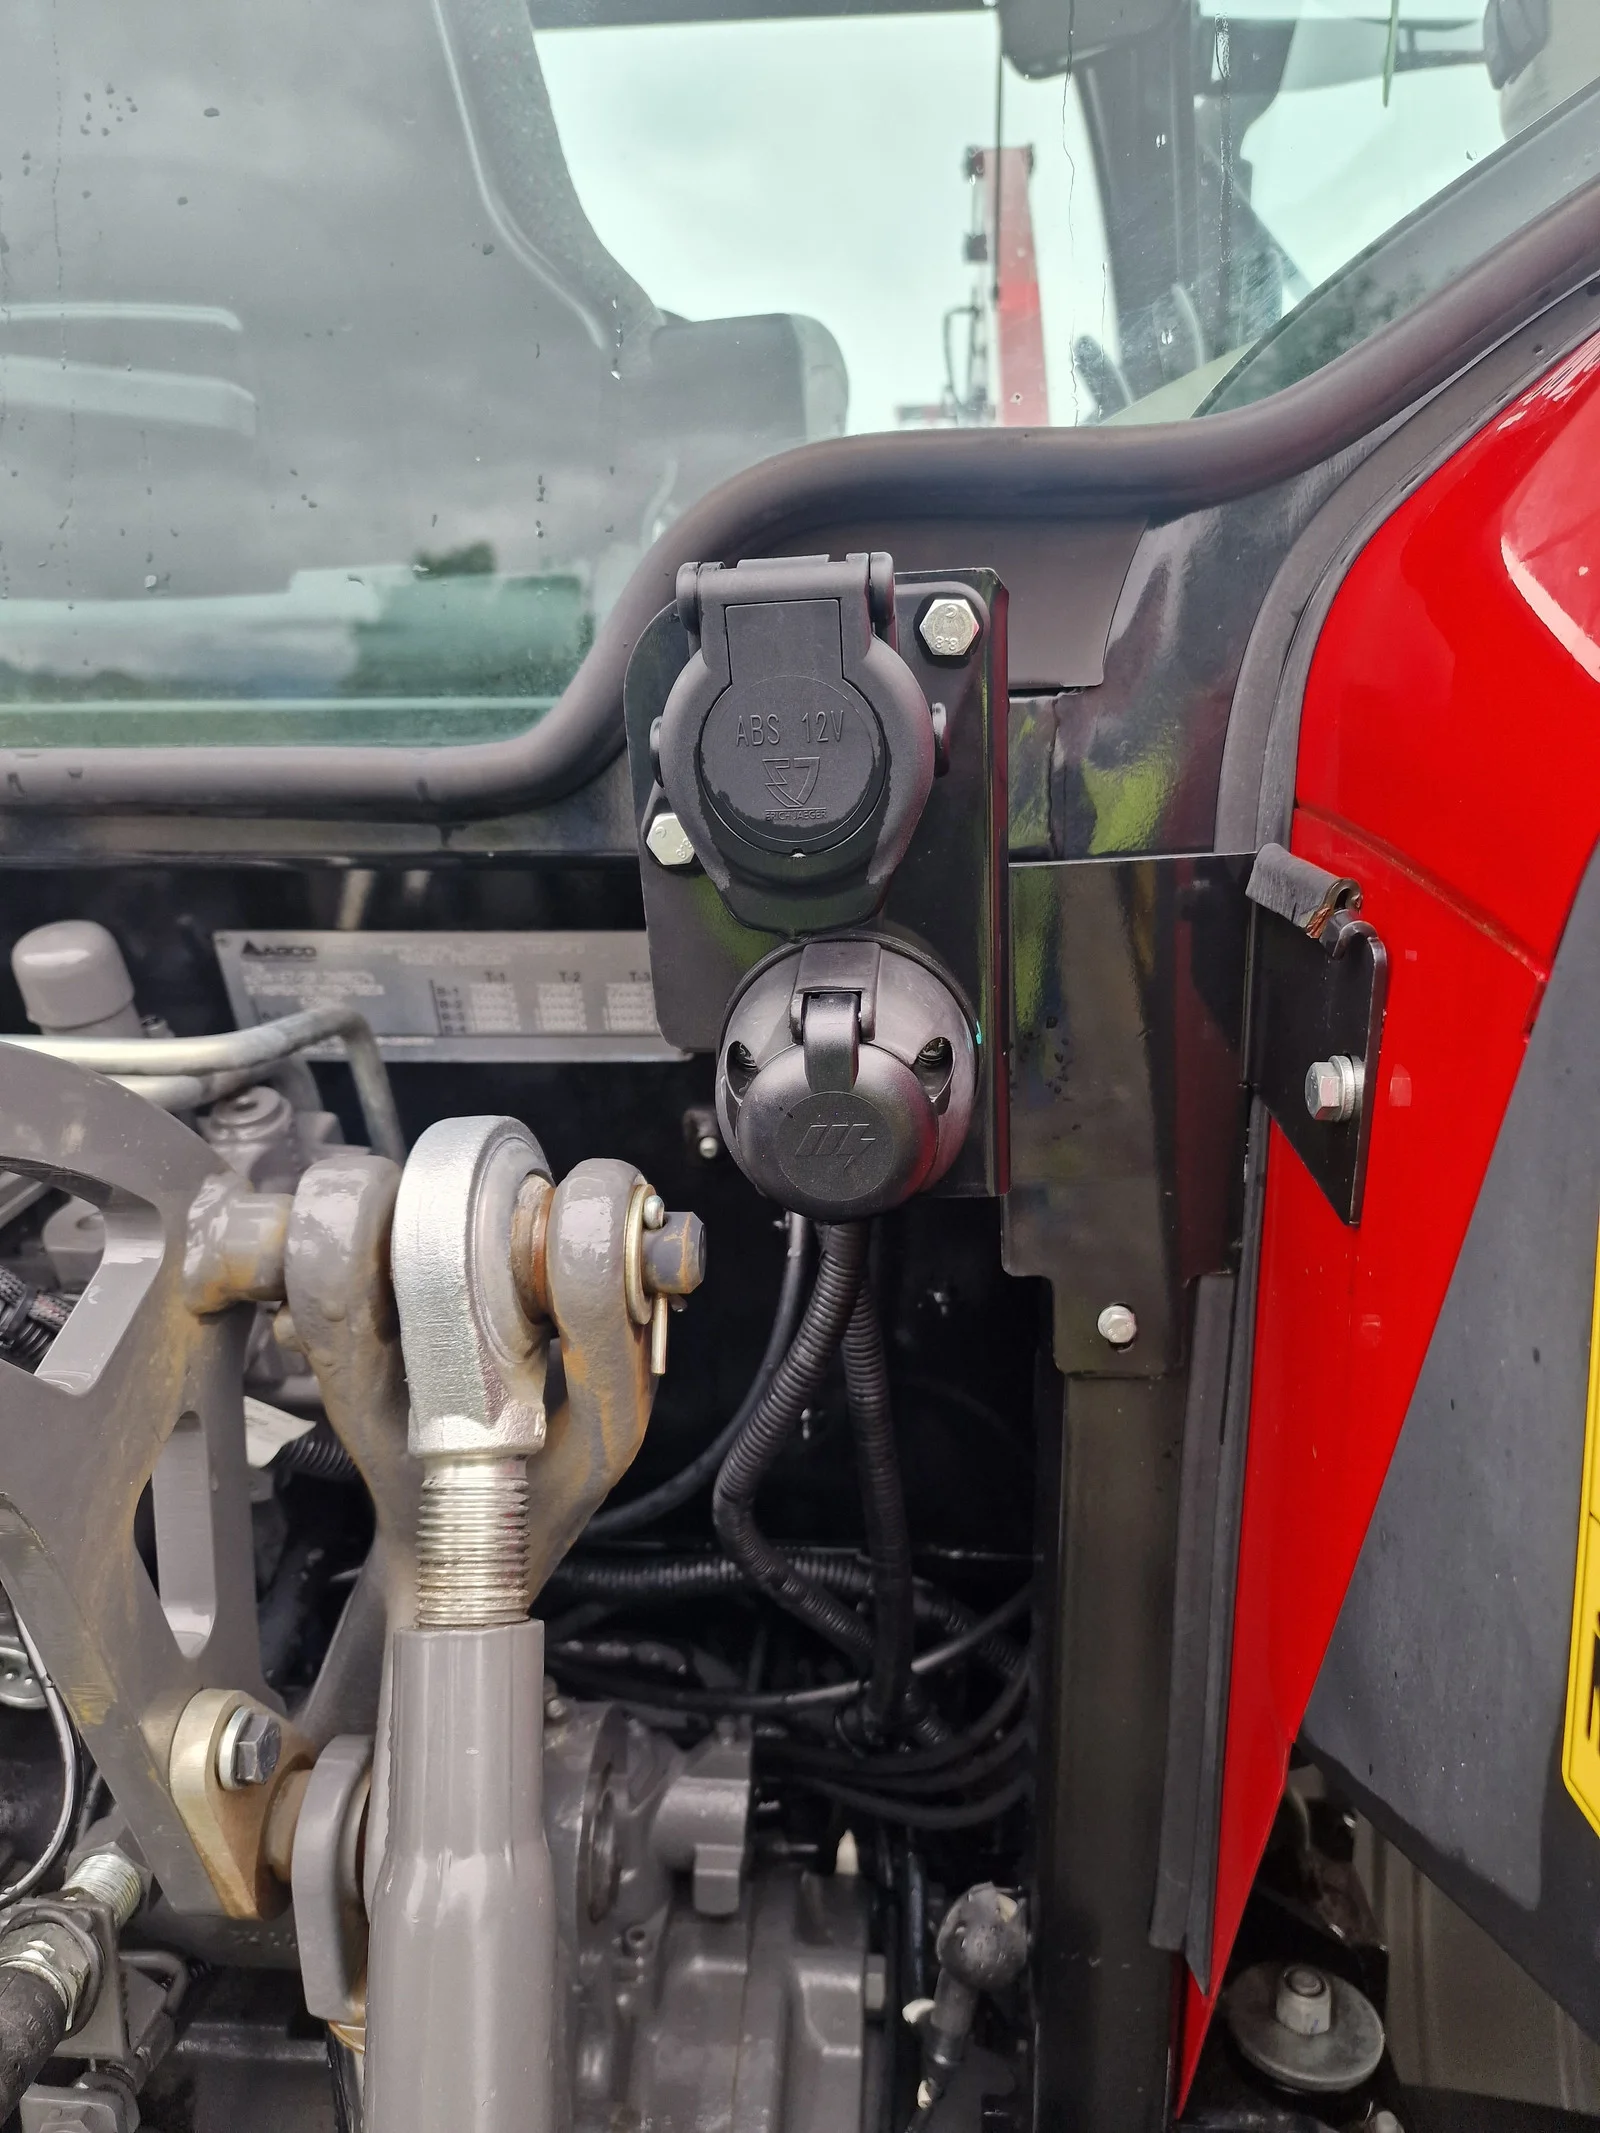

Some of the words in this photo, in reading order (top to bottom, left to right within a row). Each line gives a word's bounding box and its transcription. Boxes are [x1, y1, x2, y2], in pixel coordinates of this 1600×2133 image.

[735, 713, 780, 747] ABS
[801, 709, 844, 743] 12V
[765, 812, 790, 821] ERICH
[793, 810, 827, 820] JAEGER
[558, 971, 581, 983] T-2
